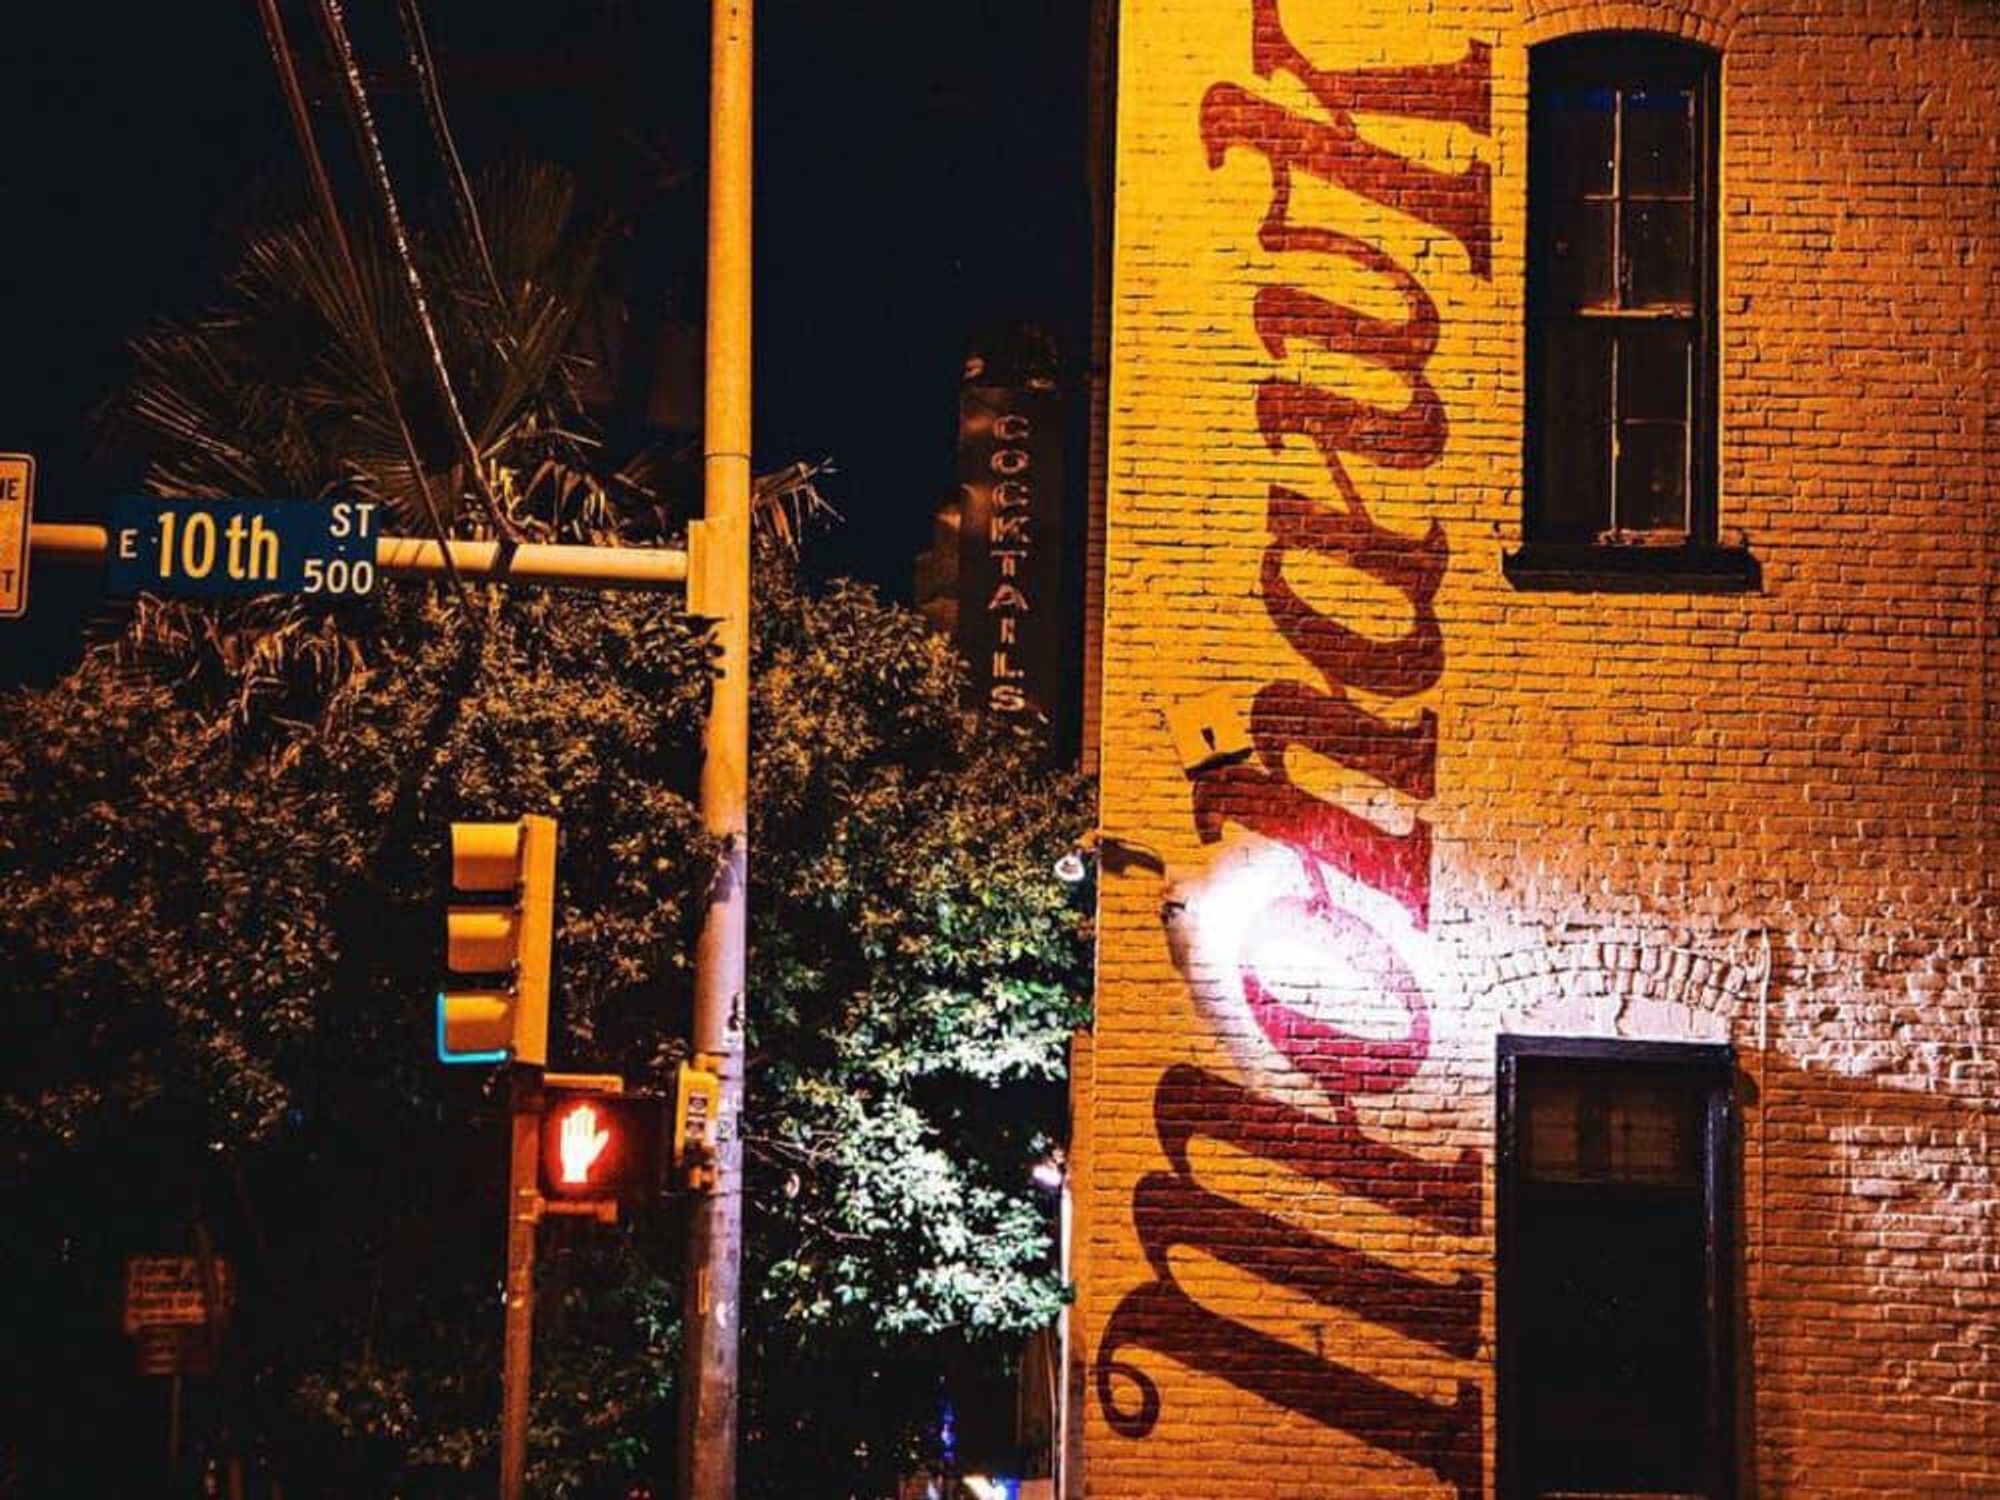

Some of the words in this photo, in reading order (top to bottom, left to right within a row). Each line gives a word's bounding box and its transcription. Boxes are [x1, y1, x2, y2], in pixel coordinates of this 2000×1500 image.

[119, 528, 138, 558] E
[158, 511, 279, 580] 10th
[329, 503, 375, 538] ST
[303, 558, 374, 594] 500
[989, 413, 1031, 712] COCKTAILS
[1098, 0, 1490, 1500] Mohawk
